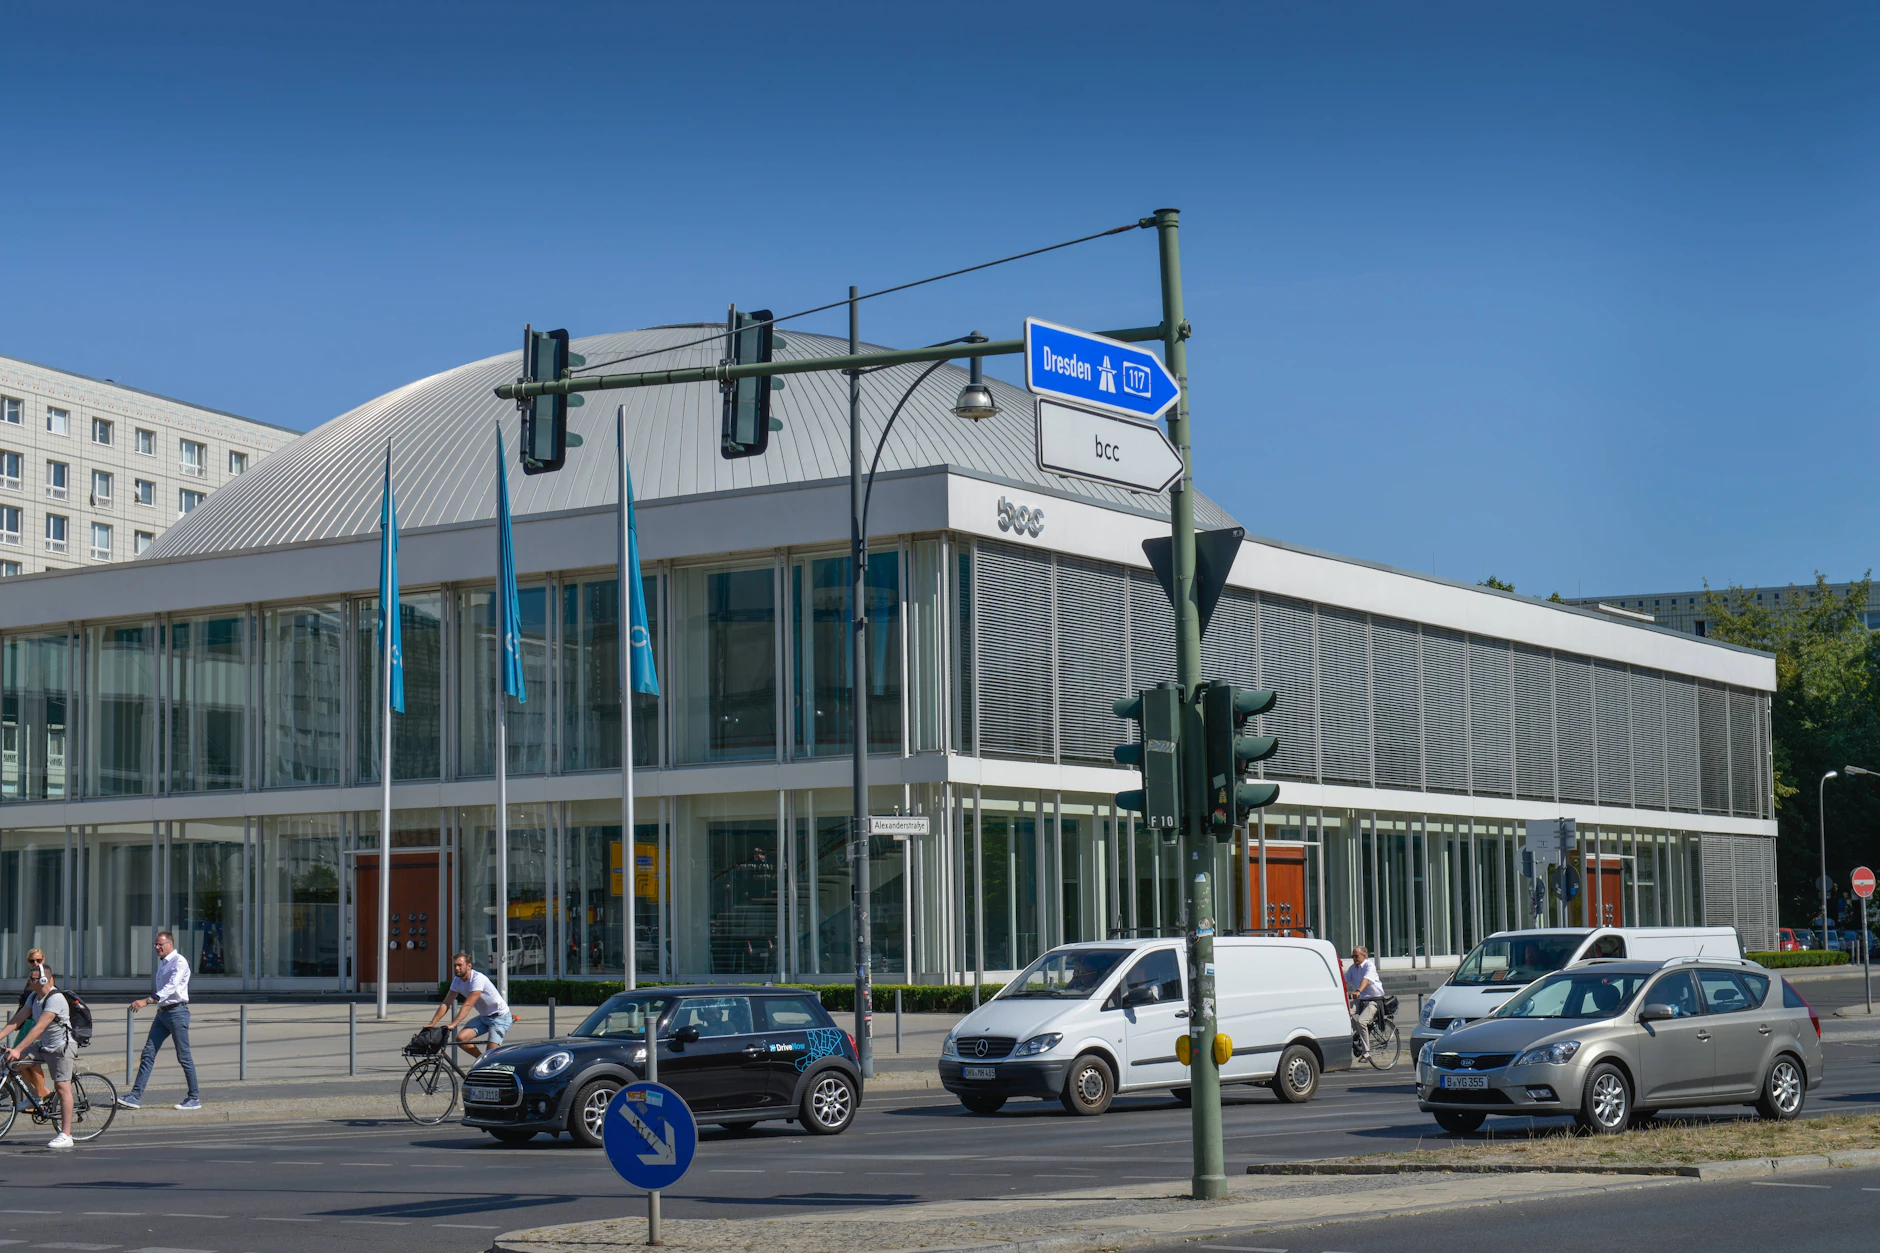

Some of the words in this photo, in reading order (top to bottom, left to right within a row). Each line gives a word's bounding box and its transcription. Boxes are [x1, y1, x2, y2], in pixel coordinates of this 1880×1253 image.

[1043, 345, 1092, 382] Dresden
[1128, 368, 1146, 391] 117
[1095, 434, 1120, 463] bcc
[999, 495, 1045, 534] bcc
[874, 820, 926, 832] Alexanderstraße
[1151, 815, 1157, 827] F
[1160, 815, 1174, 827] 10
[775, 1042, 806, 1052] DriveNow
[1446, 1077, 1453, 1088] B
[1456, 1077, 1467, 1088] YG
[1468, 1077, 1484, 1088] 355
